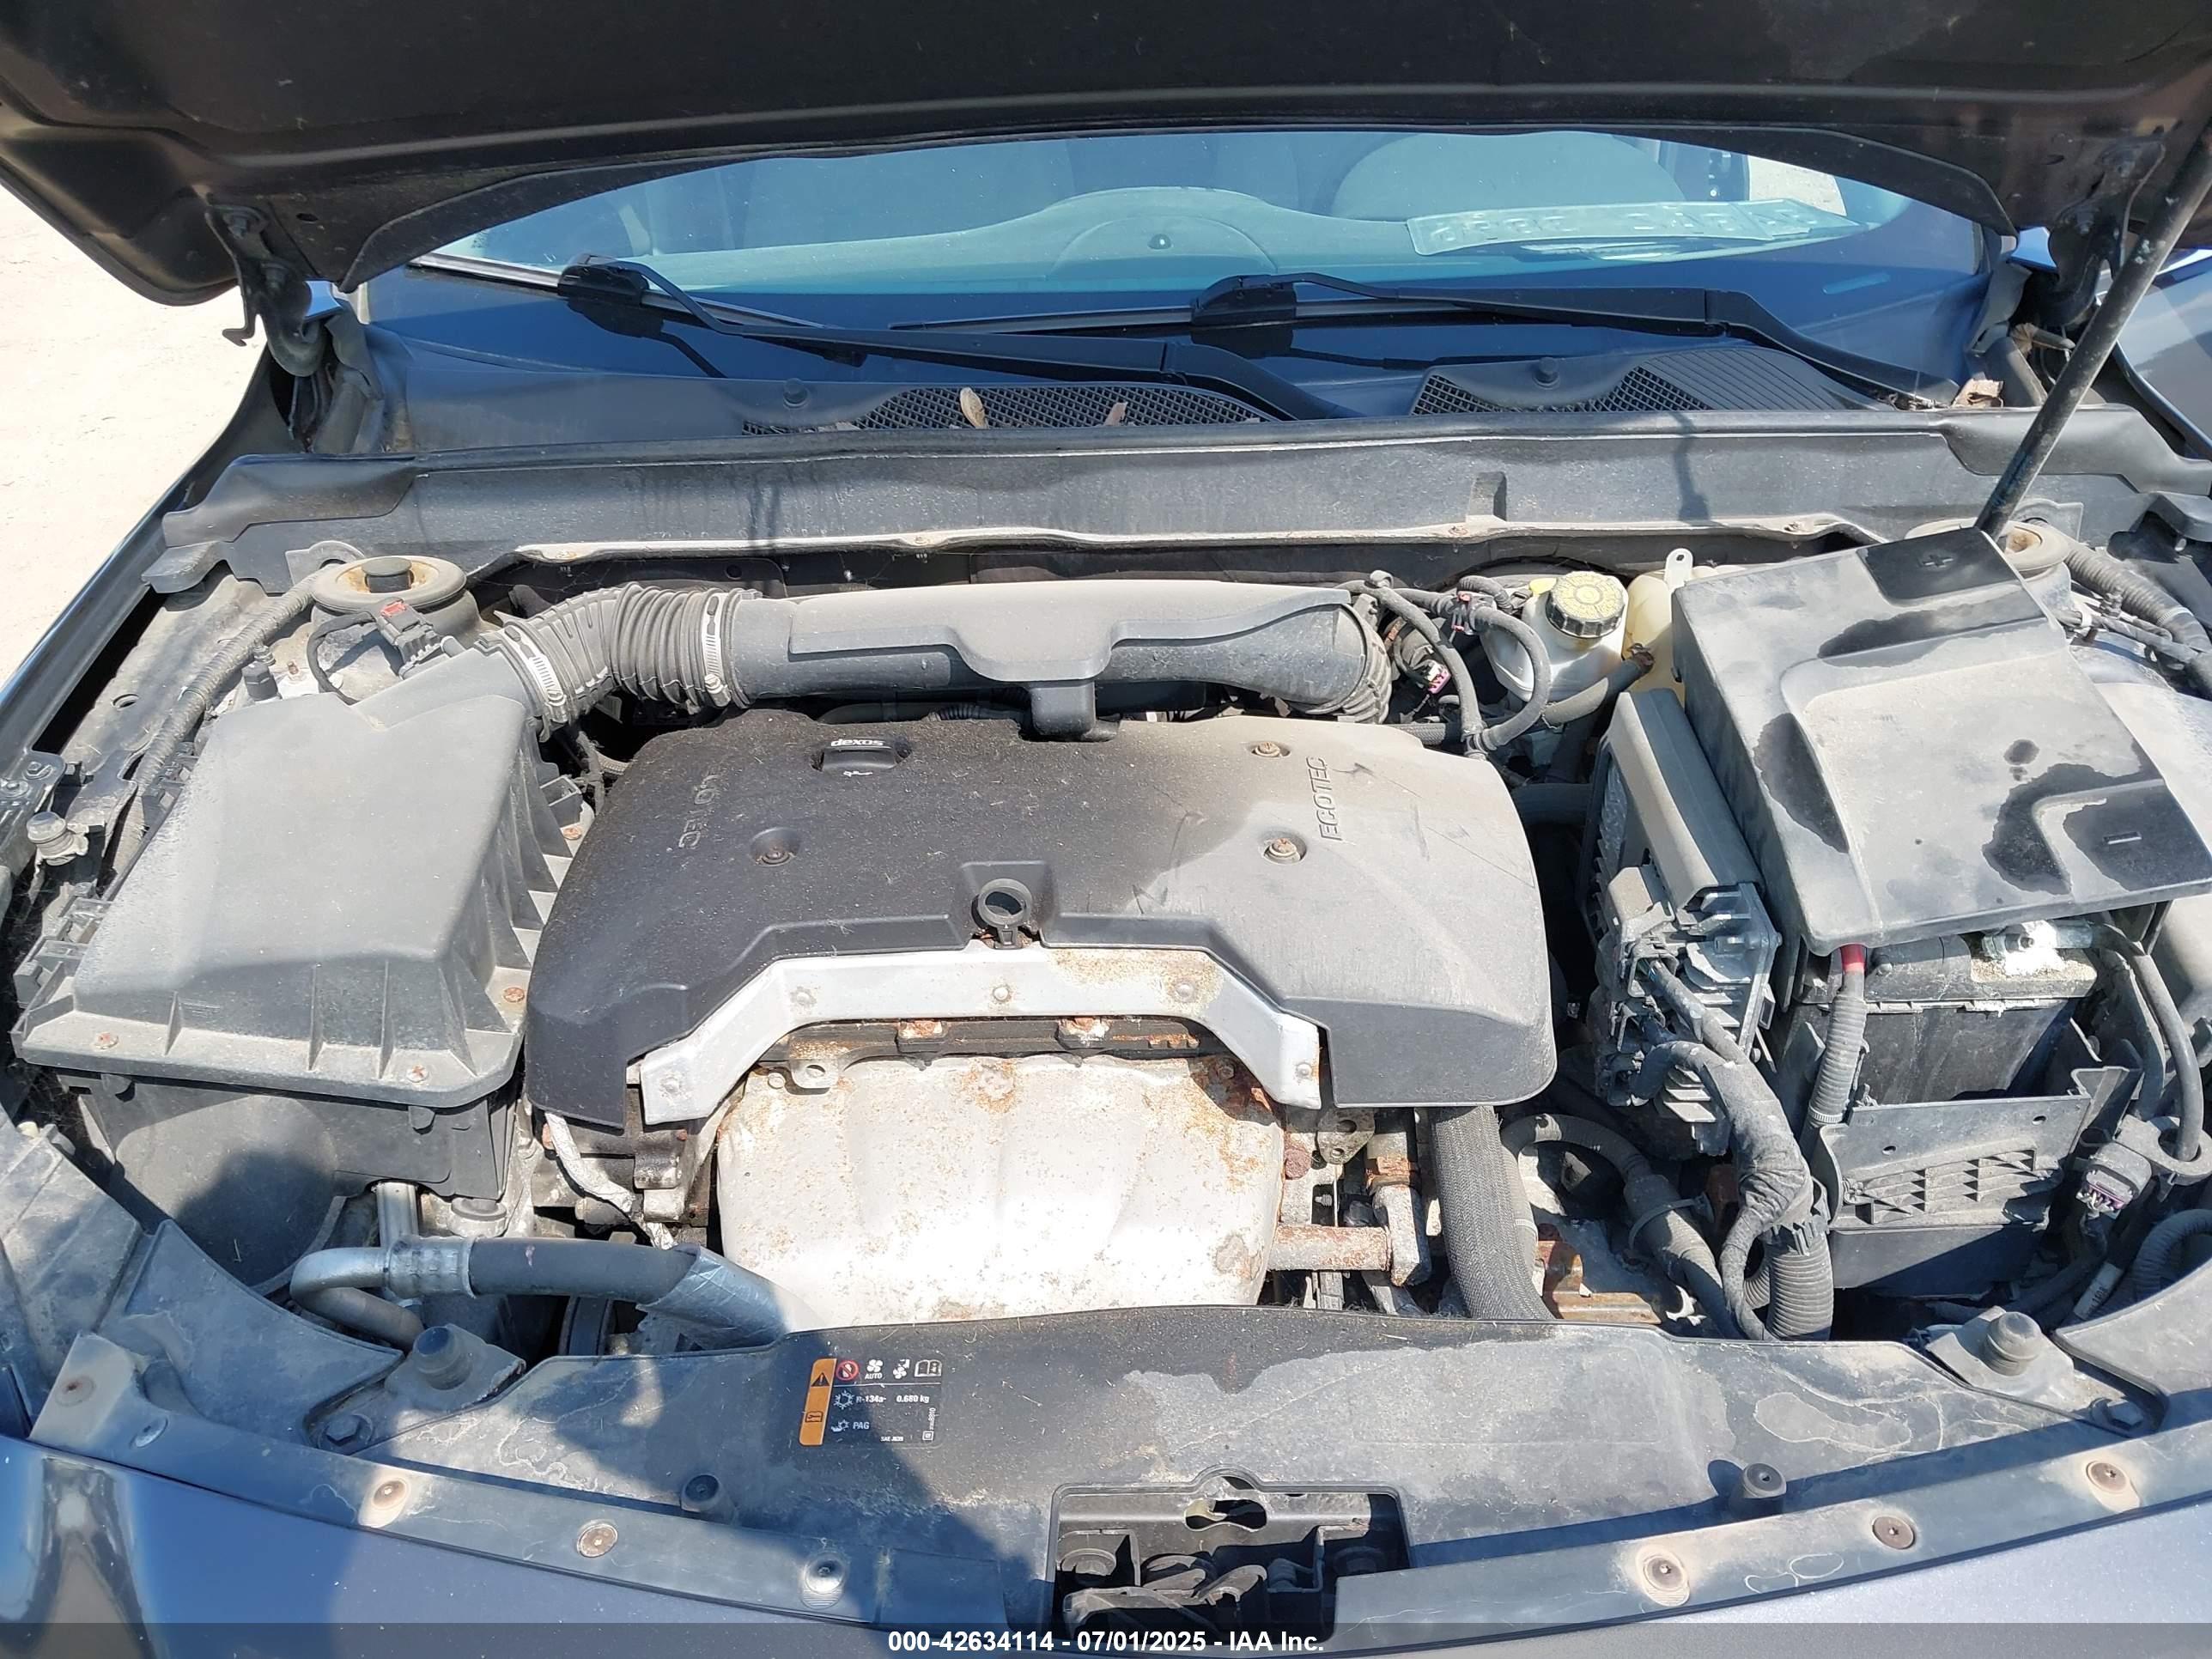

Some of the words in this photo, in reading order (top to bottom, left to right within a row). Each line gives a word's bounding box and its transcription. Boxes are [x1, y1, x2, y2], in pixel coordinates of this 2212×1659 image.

[830, 738, 885, 747] dexos
[1305, 756, 1342, 841] ECOTEC
[853, 1421, 870, 1430] PAG
